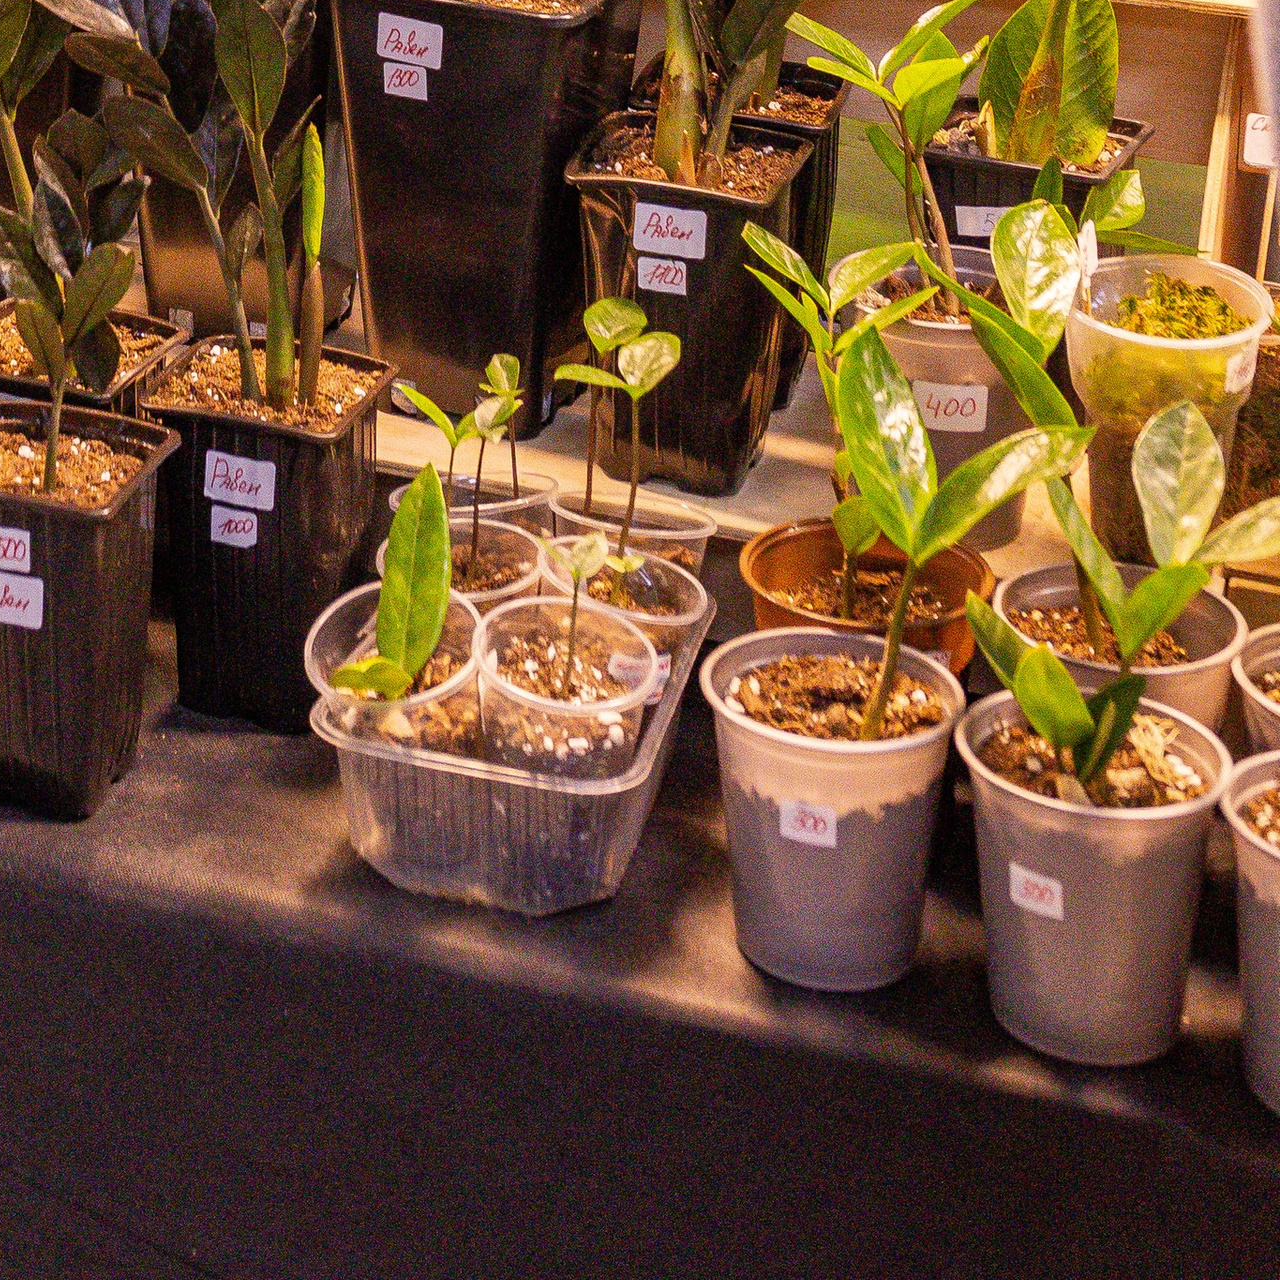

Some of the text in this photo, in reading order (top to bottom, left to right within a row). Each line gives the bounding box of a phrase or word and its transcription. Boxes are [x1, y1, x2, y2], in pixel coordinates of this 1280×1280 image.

[383, 27, 429, 58] Равен
[642, 211, 694, 241] Равен
[926, 393, 977, 420] 400
[210, 456, 262, 496] Равен
